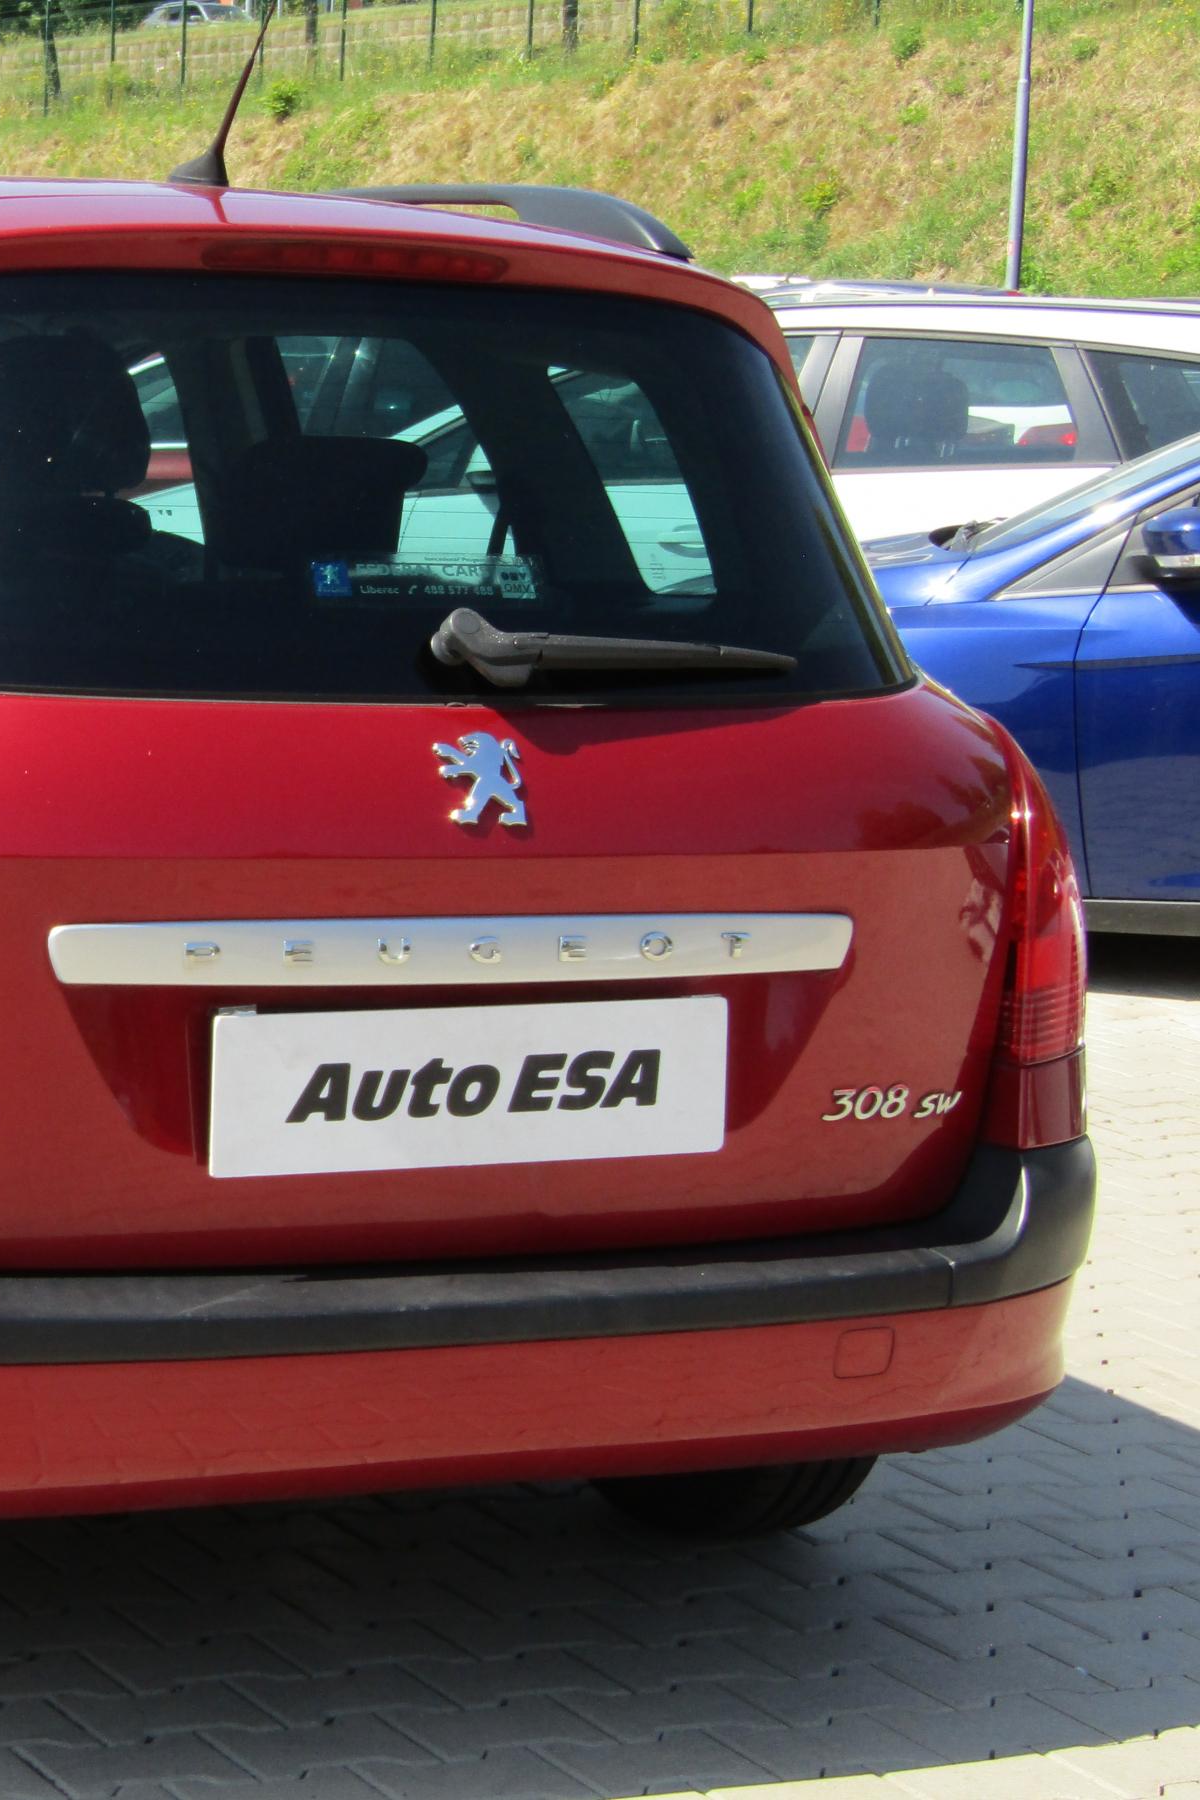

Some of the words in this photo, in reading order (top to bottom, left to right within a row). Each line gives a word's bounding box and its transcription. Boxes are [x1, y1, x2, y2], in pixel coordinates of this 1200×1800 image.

[442, 564, 490, 577] CARS
[360, 584, 400, 595] Liberec
[184, 930, 751, 967] PEUGEOT
[285, 1057, 501, 1123] Auto
[507, 1049, 661, 1113] ESA
[821, 1084, 910, 1121] 308
